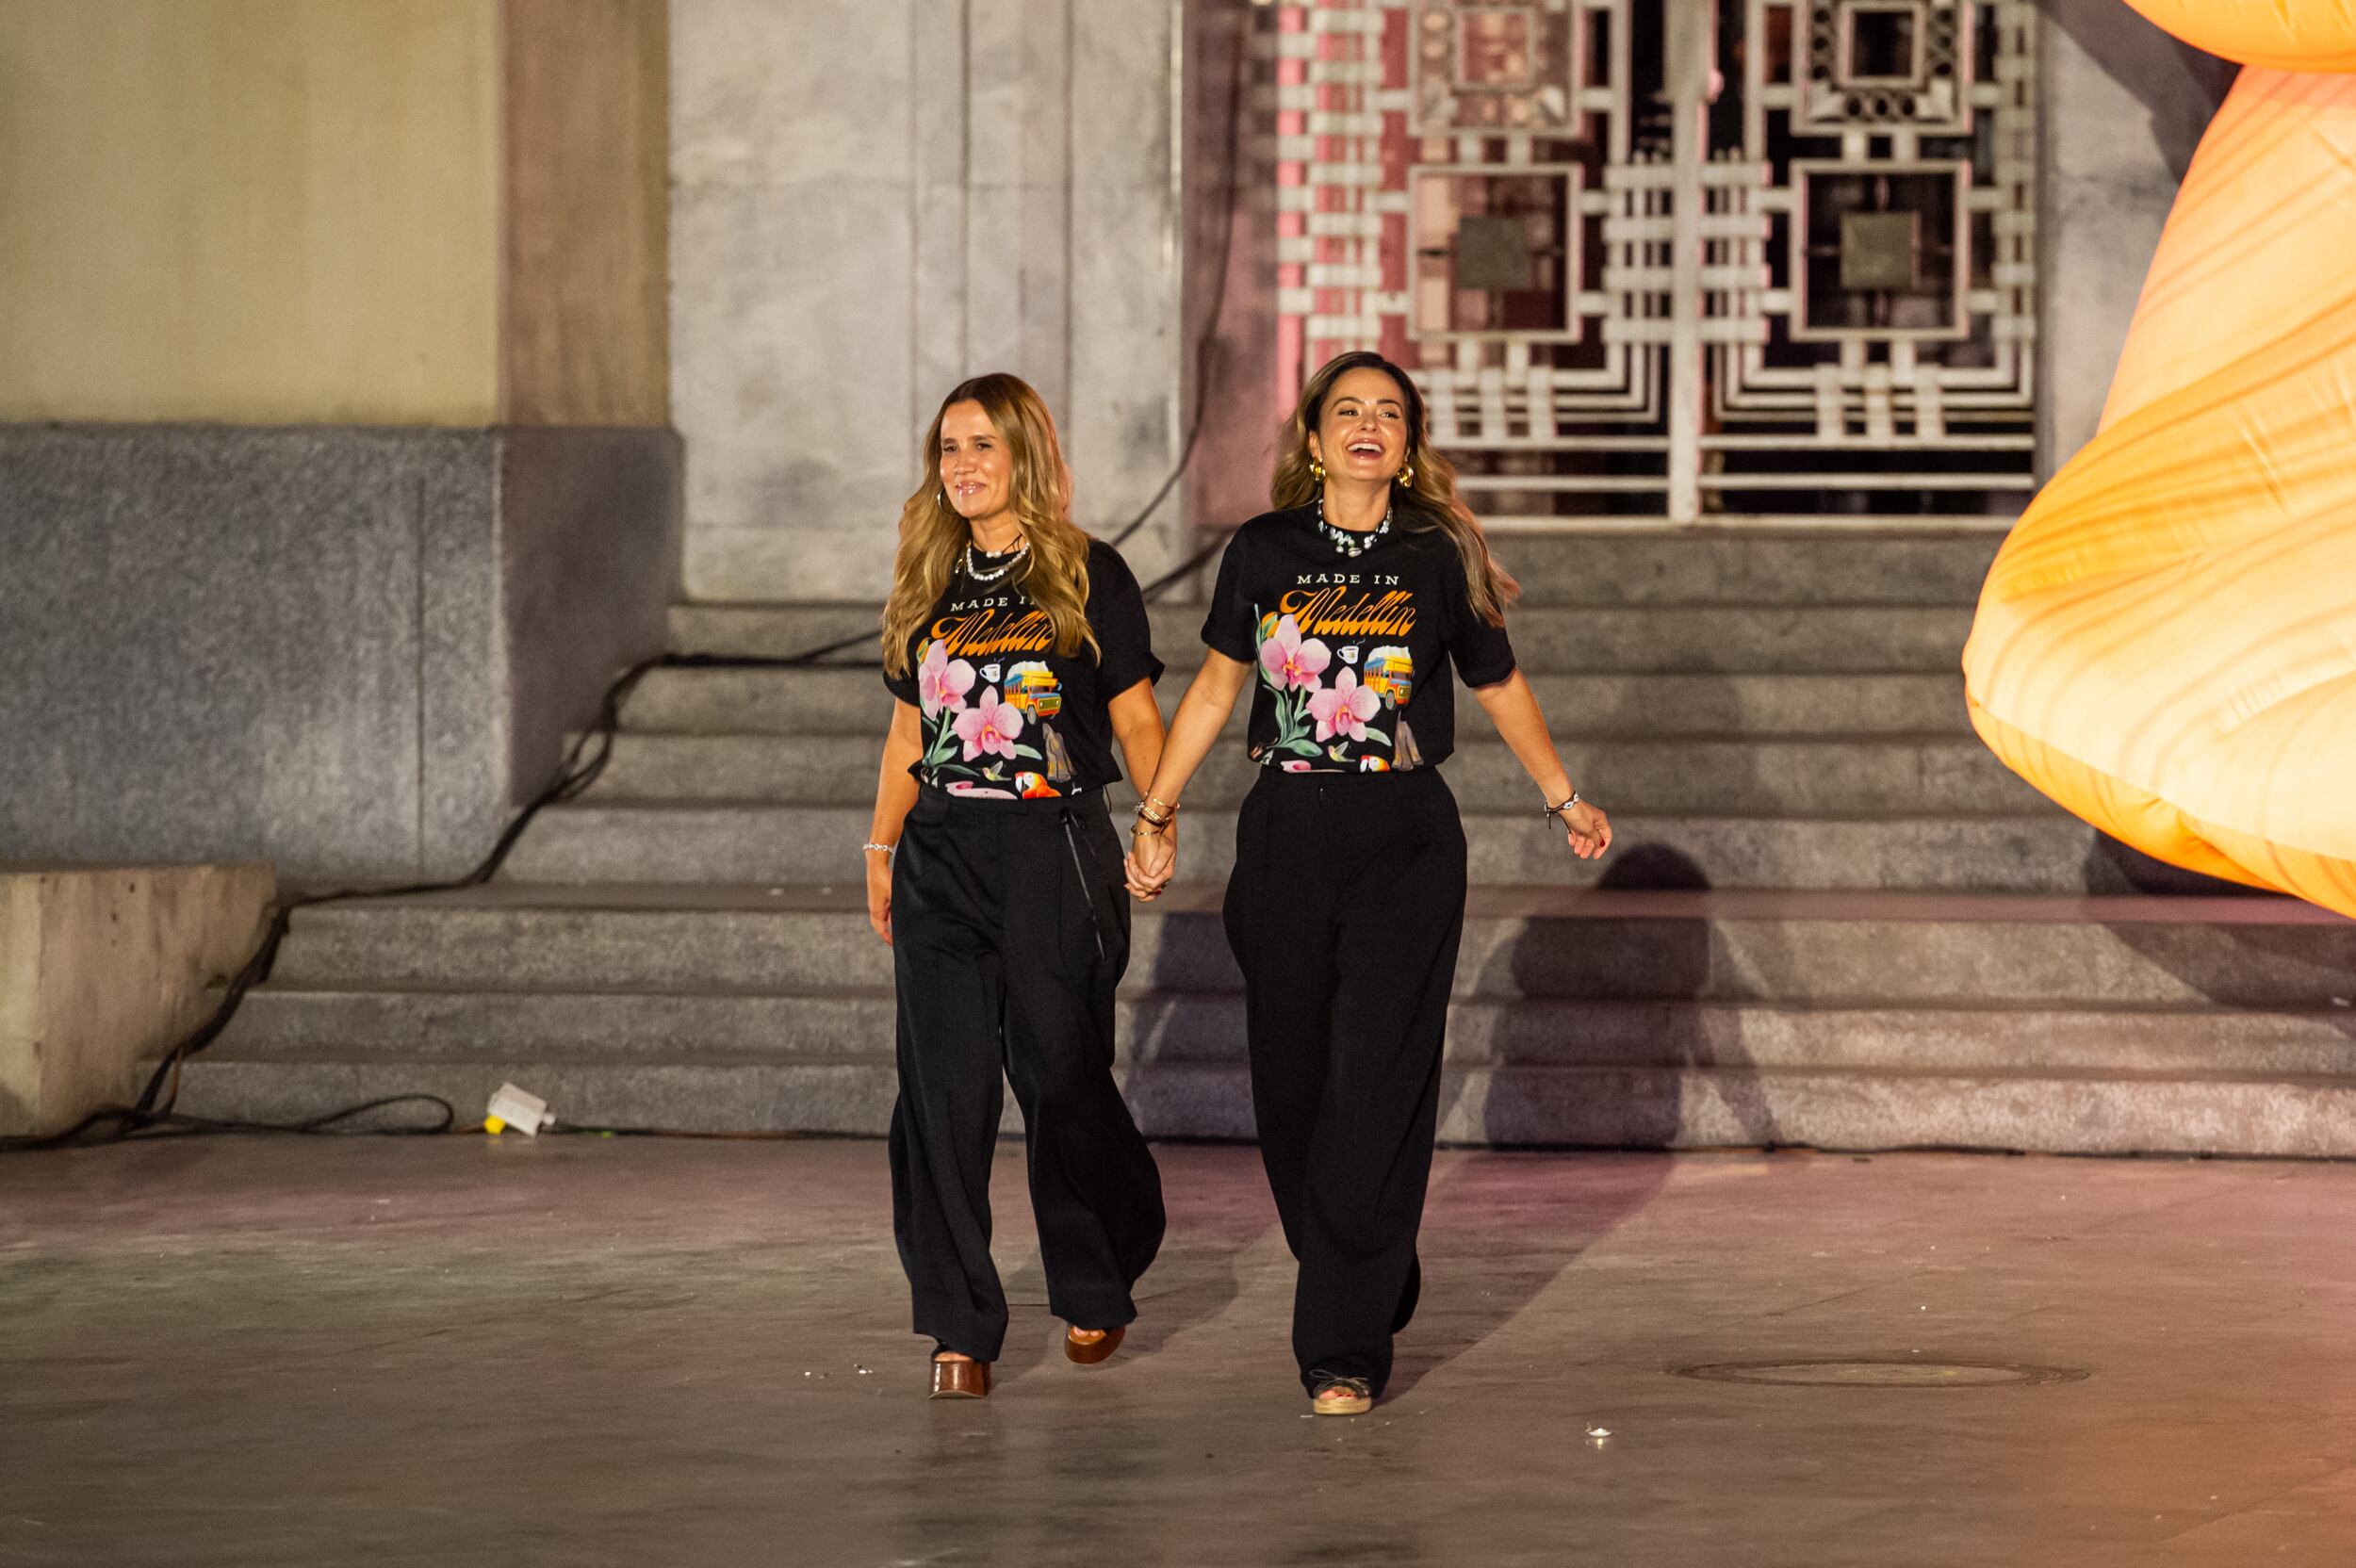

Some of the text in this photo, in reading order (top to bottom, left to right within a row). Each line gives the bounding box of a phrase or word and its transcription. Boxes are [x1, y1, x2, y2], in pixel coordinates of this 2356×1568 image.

[1297, 573, 1399, 585] MADE IN
[950, 596, 1008, 612] MADE
